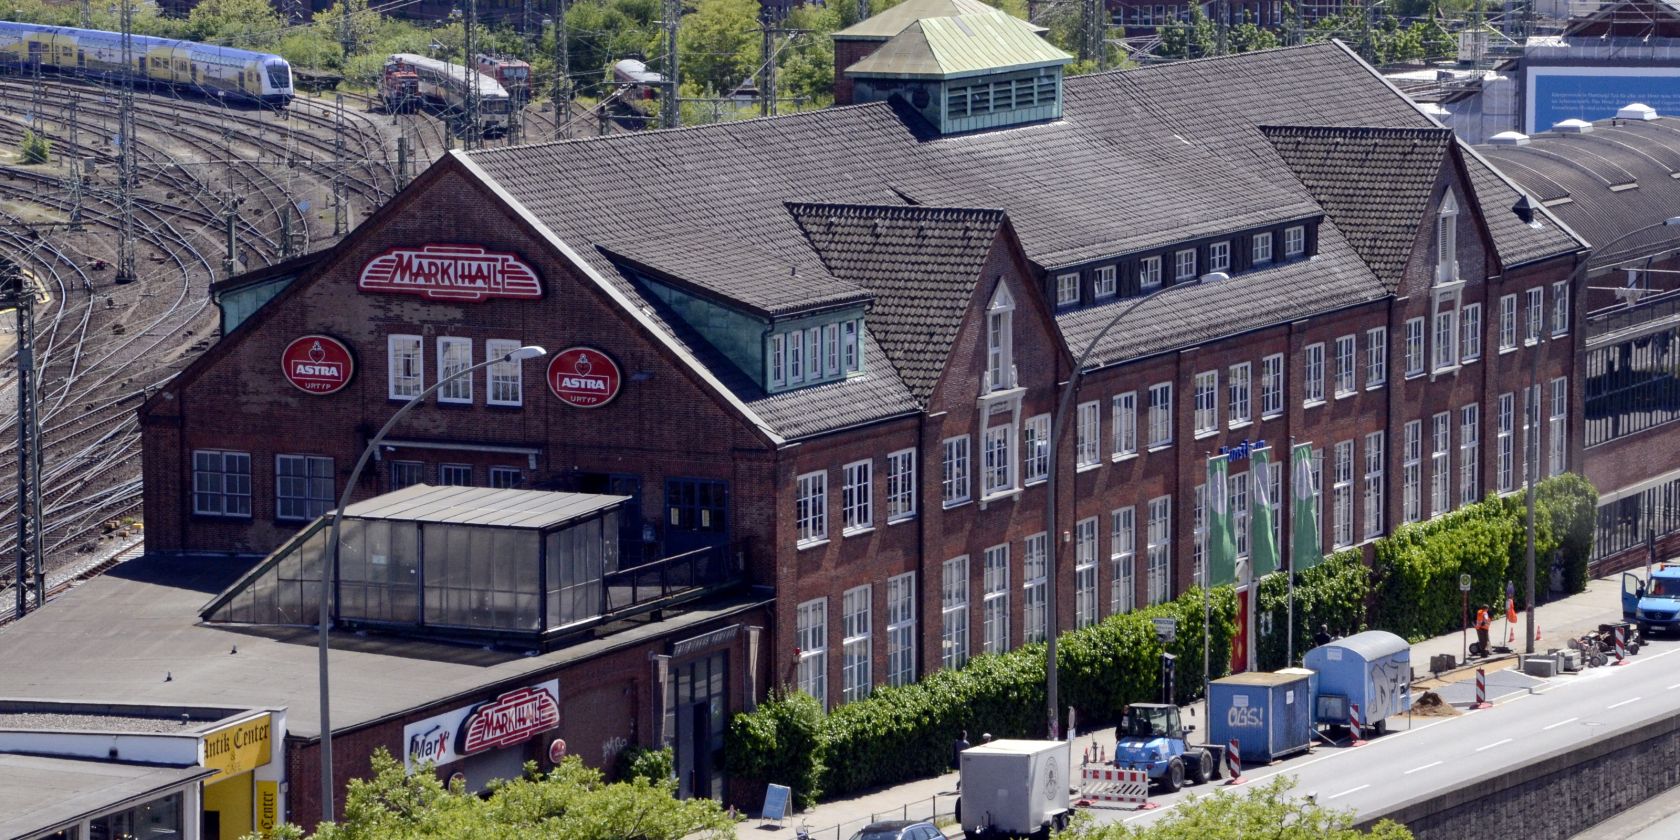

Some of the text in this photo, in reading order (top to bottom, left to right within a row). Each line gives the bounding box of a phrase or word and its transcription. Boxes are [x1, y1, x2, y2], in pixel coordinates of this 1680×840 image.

[296, 364, 339, 377] ASTRA
[561, 377, 606, 390] ASTRA
[233, 723, 270, 749] Center
[261, 791, 274, 830] Center
